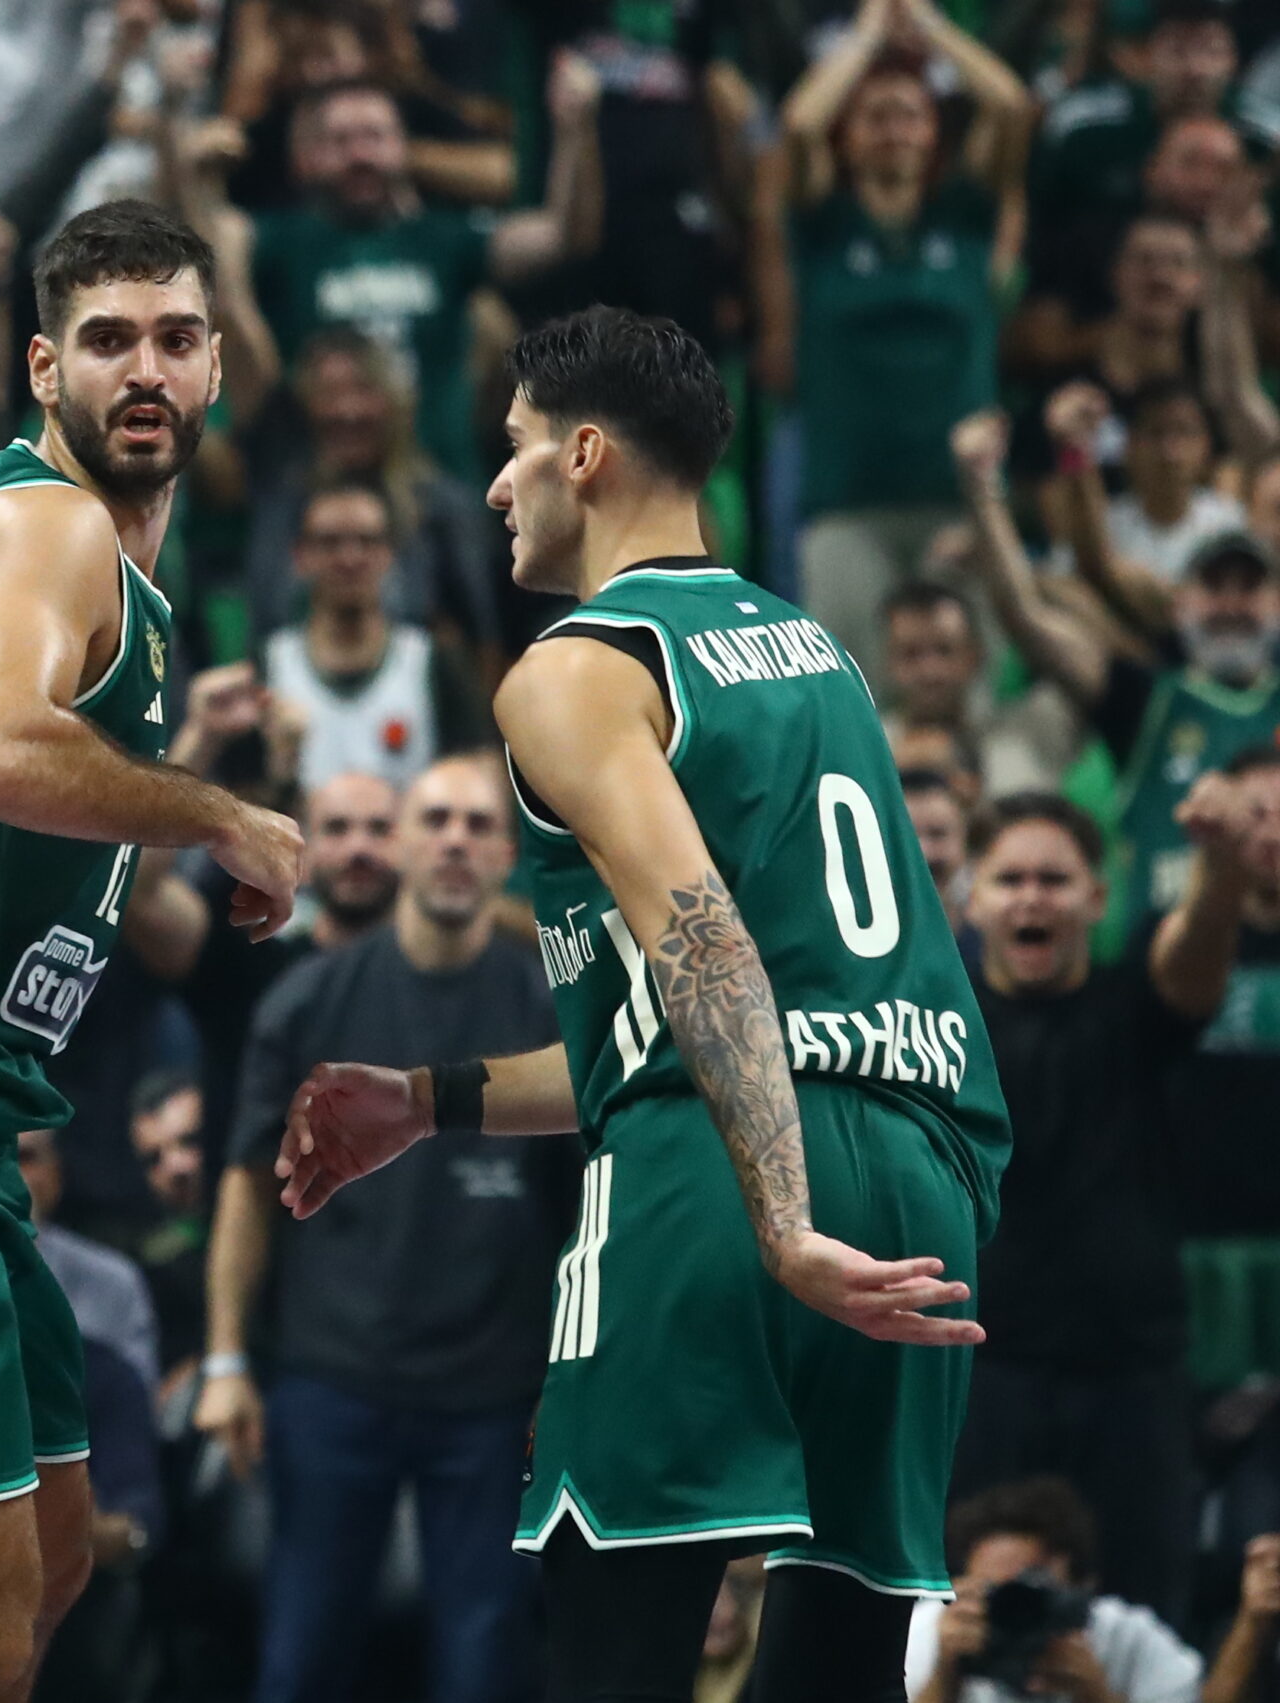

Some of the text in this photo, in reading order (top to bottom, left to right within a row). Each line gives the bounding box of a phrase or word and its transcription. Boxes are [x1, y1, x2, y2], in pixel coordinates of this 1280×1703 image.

[818, 773, 900, 958] 0
[44, 938, 85, 967] pame
[785, 998, 967, 1095] ATHENS
